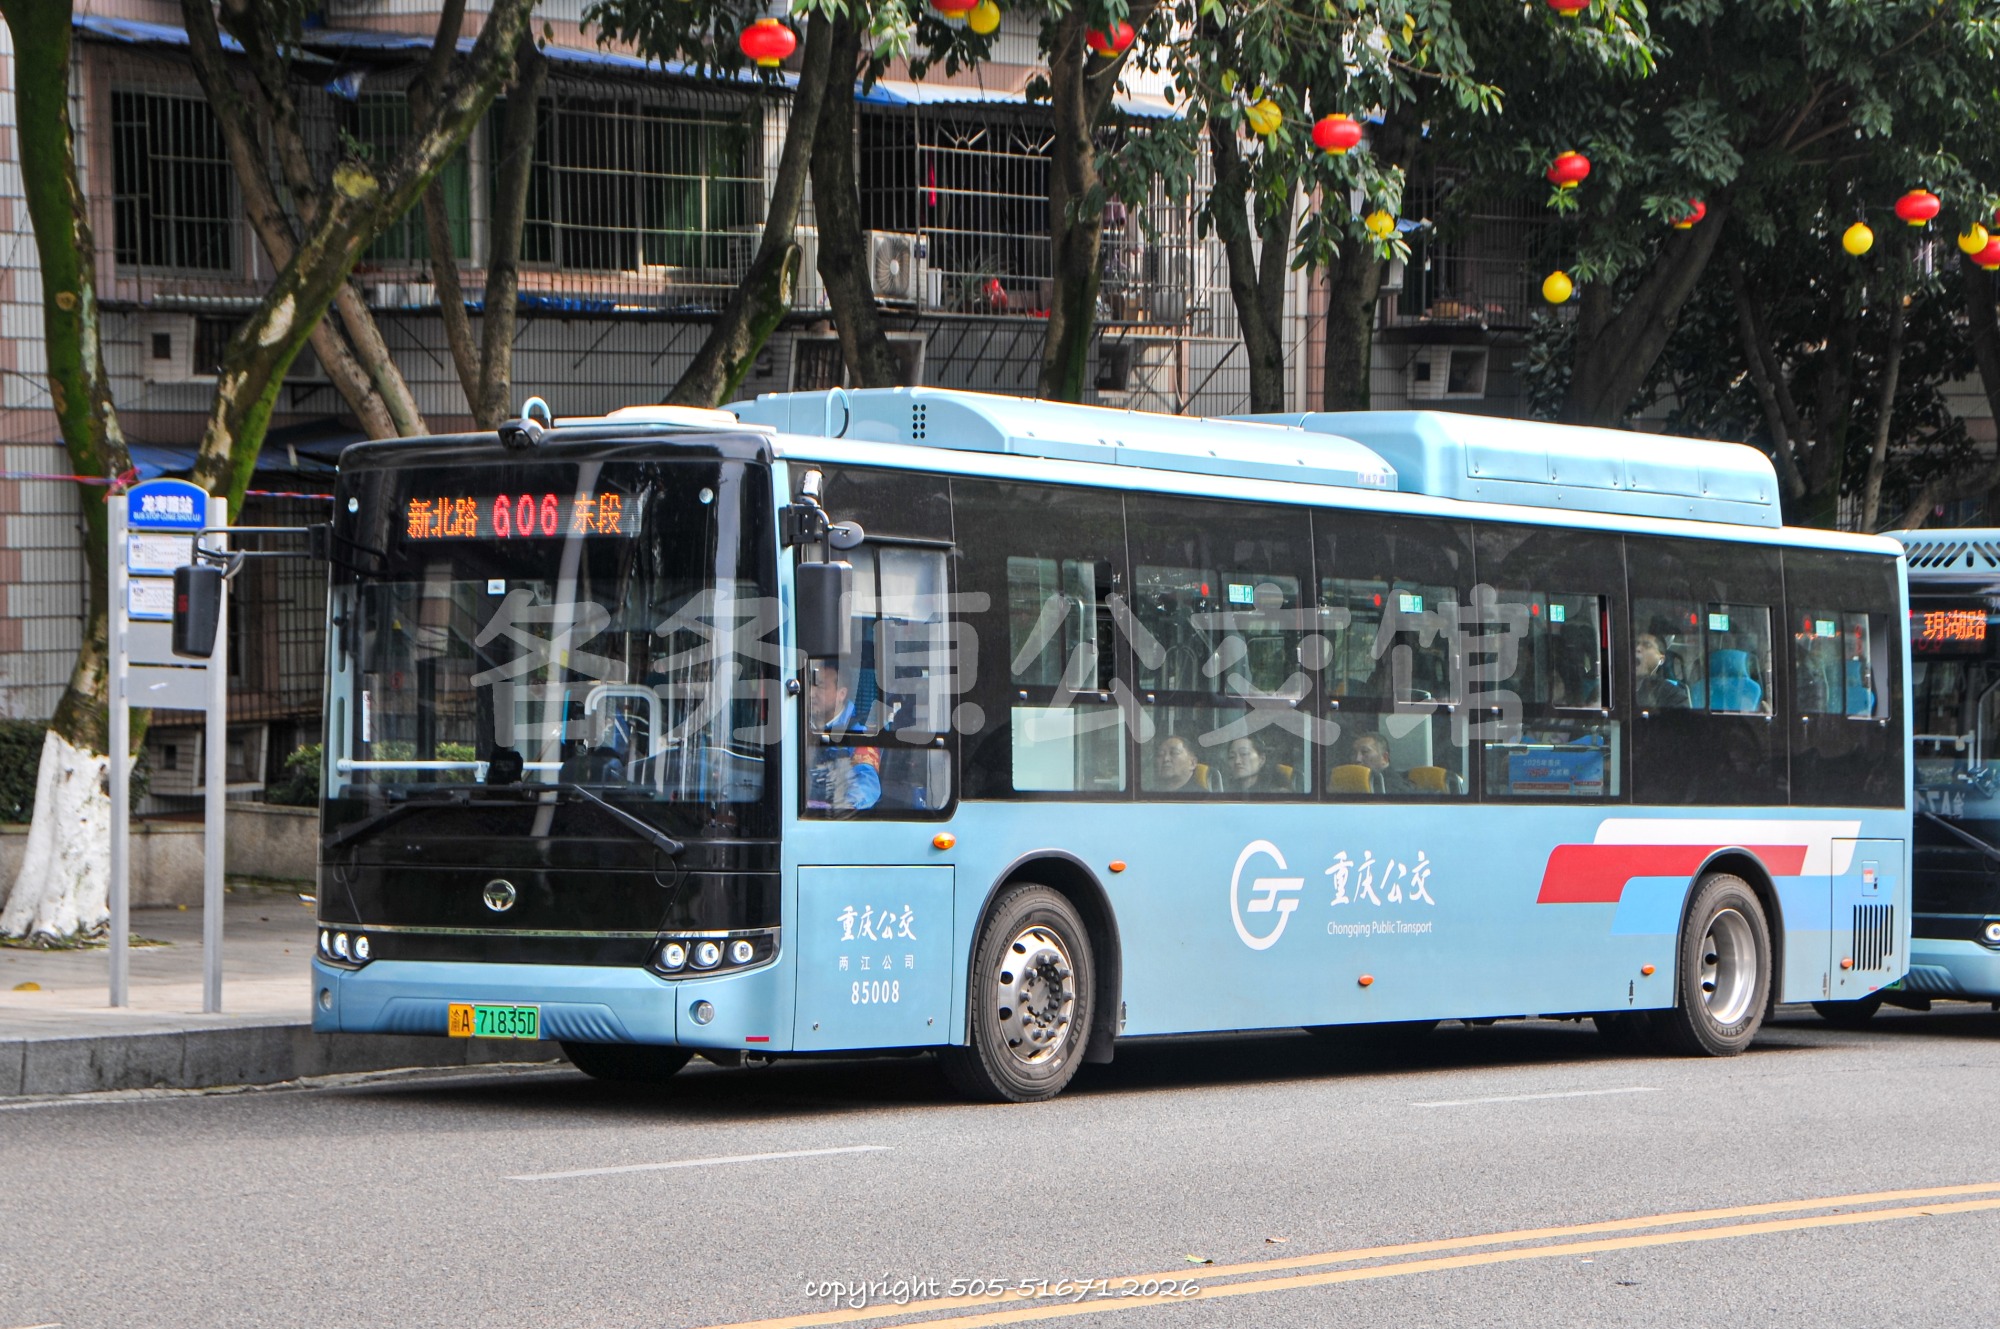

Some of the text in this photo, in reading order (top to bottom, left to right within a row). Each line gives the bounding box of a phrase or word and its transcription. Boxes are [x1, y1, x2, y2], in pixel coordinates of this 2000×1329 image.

[407, 492, 622, 538] 新北路 606 东段
[1922, 609, 1987, 640] 玥湖路
[1324, 850, 1436, 907] 重庆公交
[836, 904, 917, 941] 重庆公交
[1327, 920, 1433, 938] Chongqing Public Transport
[838, 954, 914, 971] 两江公司
[851, 980, 900, 1005] 85008
